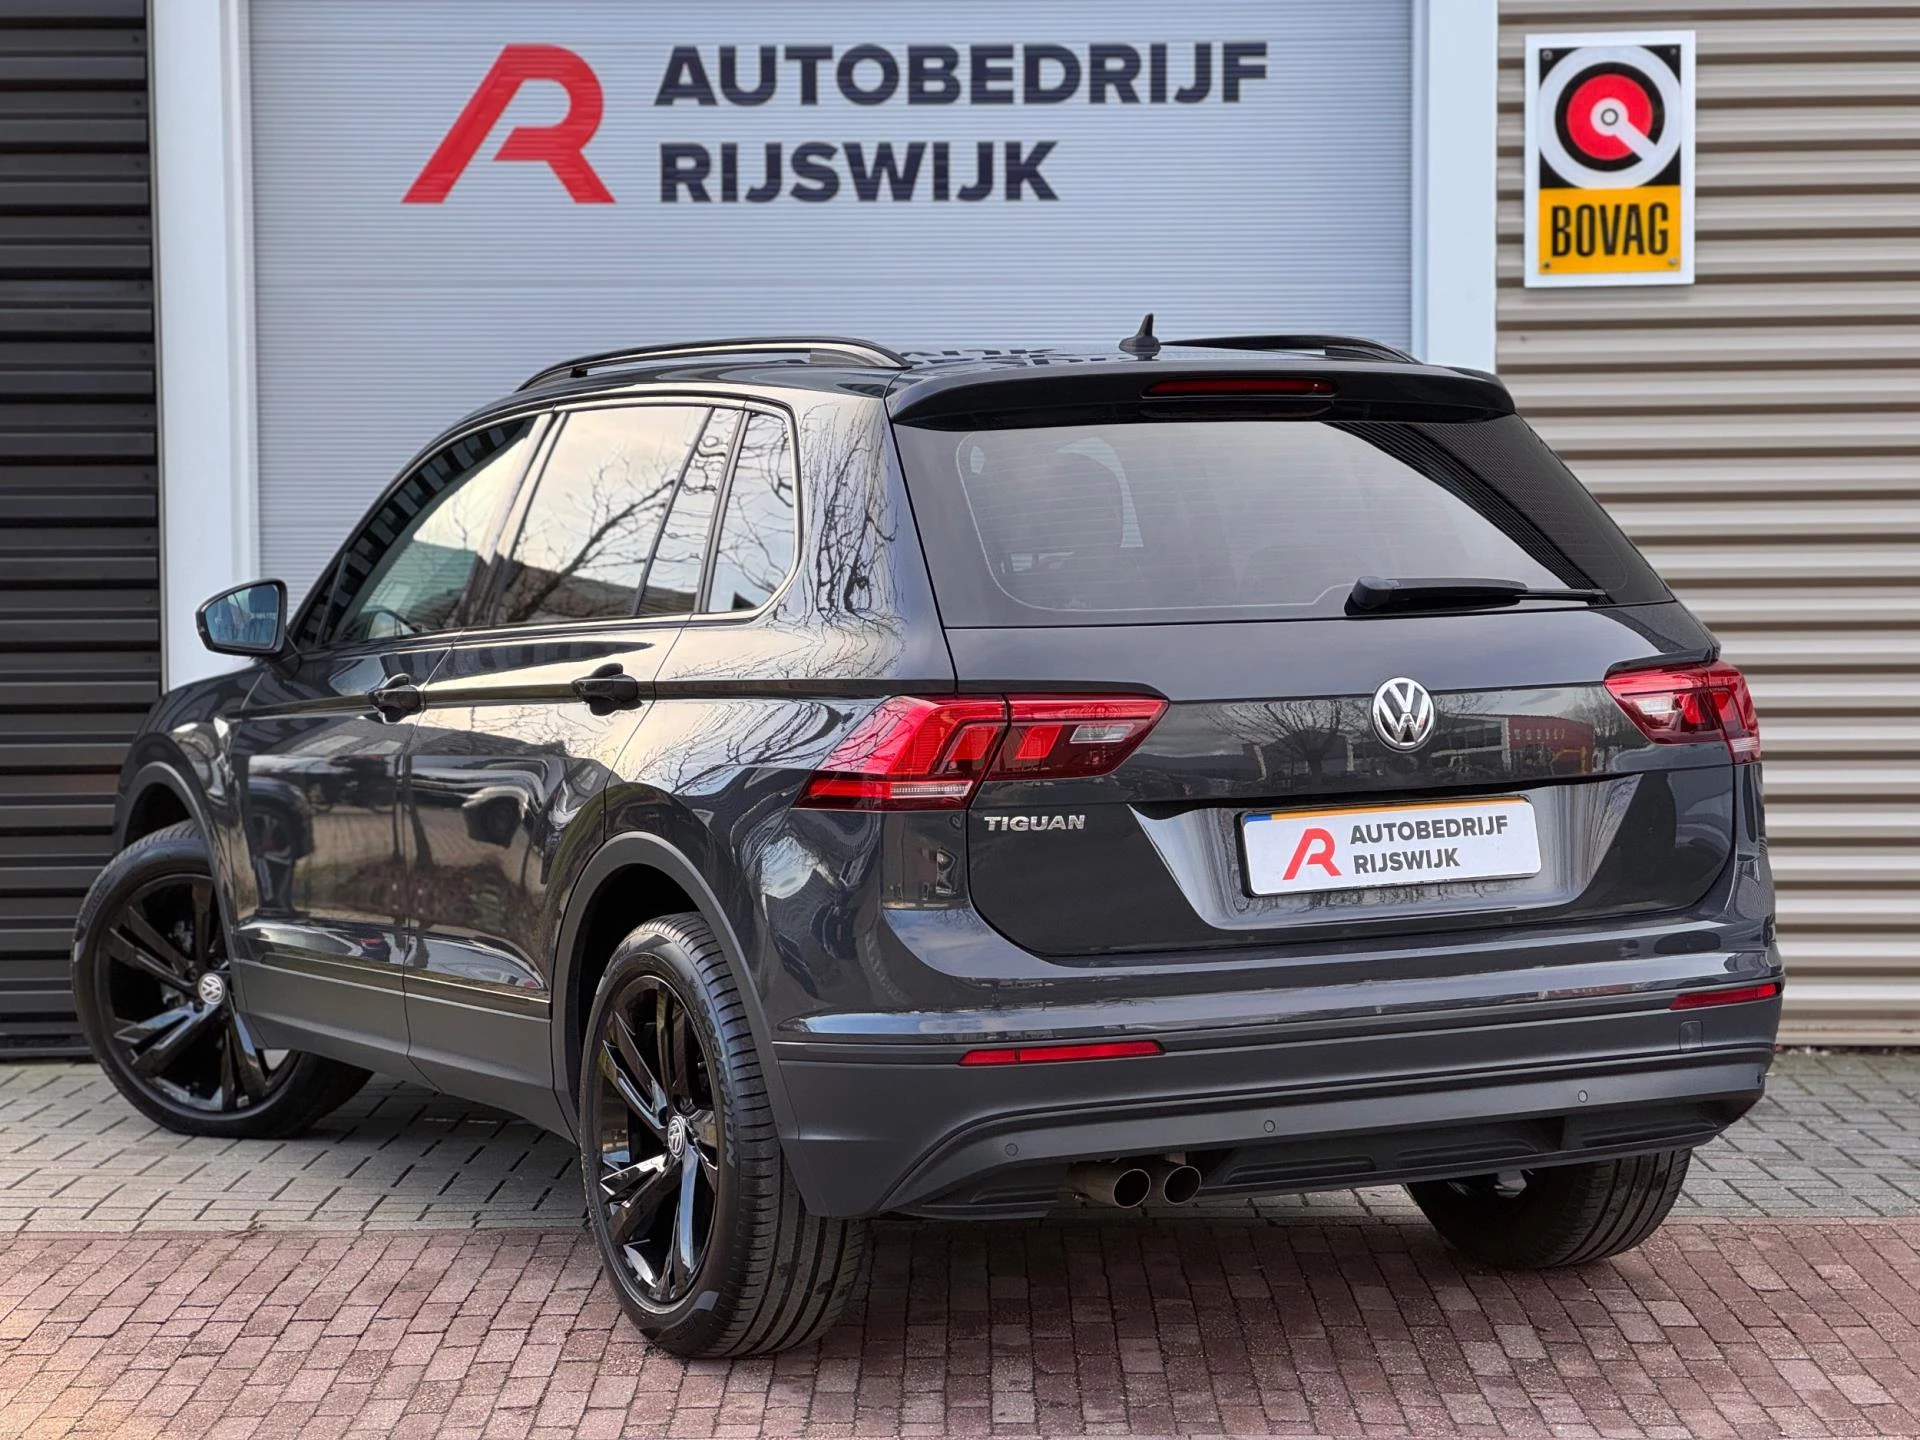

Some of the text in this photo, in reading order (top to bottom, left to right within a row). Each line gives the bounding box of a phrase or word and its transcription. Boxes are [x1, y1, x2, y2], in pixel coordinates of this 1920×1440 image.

[654, 41, 1268, 106] AUTOBEDRIJF
[659, 140, 1060, 203] RIJSWIJK
[1551, 202, 1669, 257] BOVAG
[984, 814, 1086, 832] TIGUAN
[1350, 815, 1509, 845] AUTOBEDRIJF
[1353, 848, 1461, 874] RIJSWIJK
